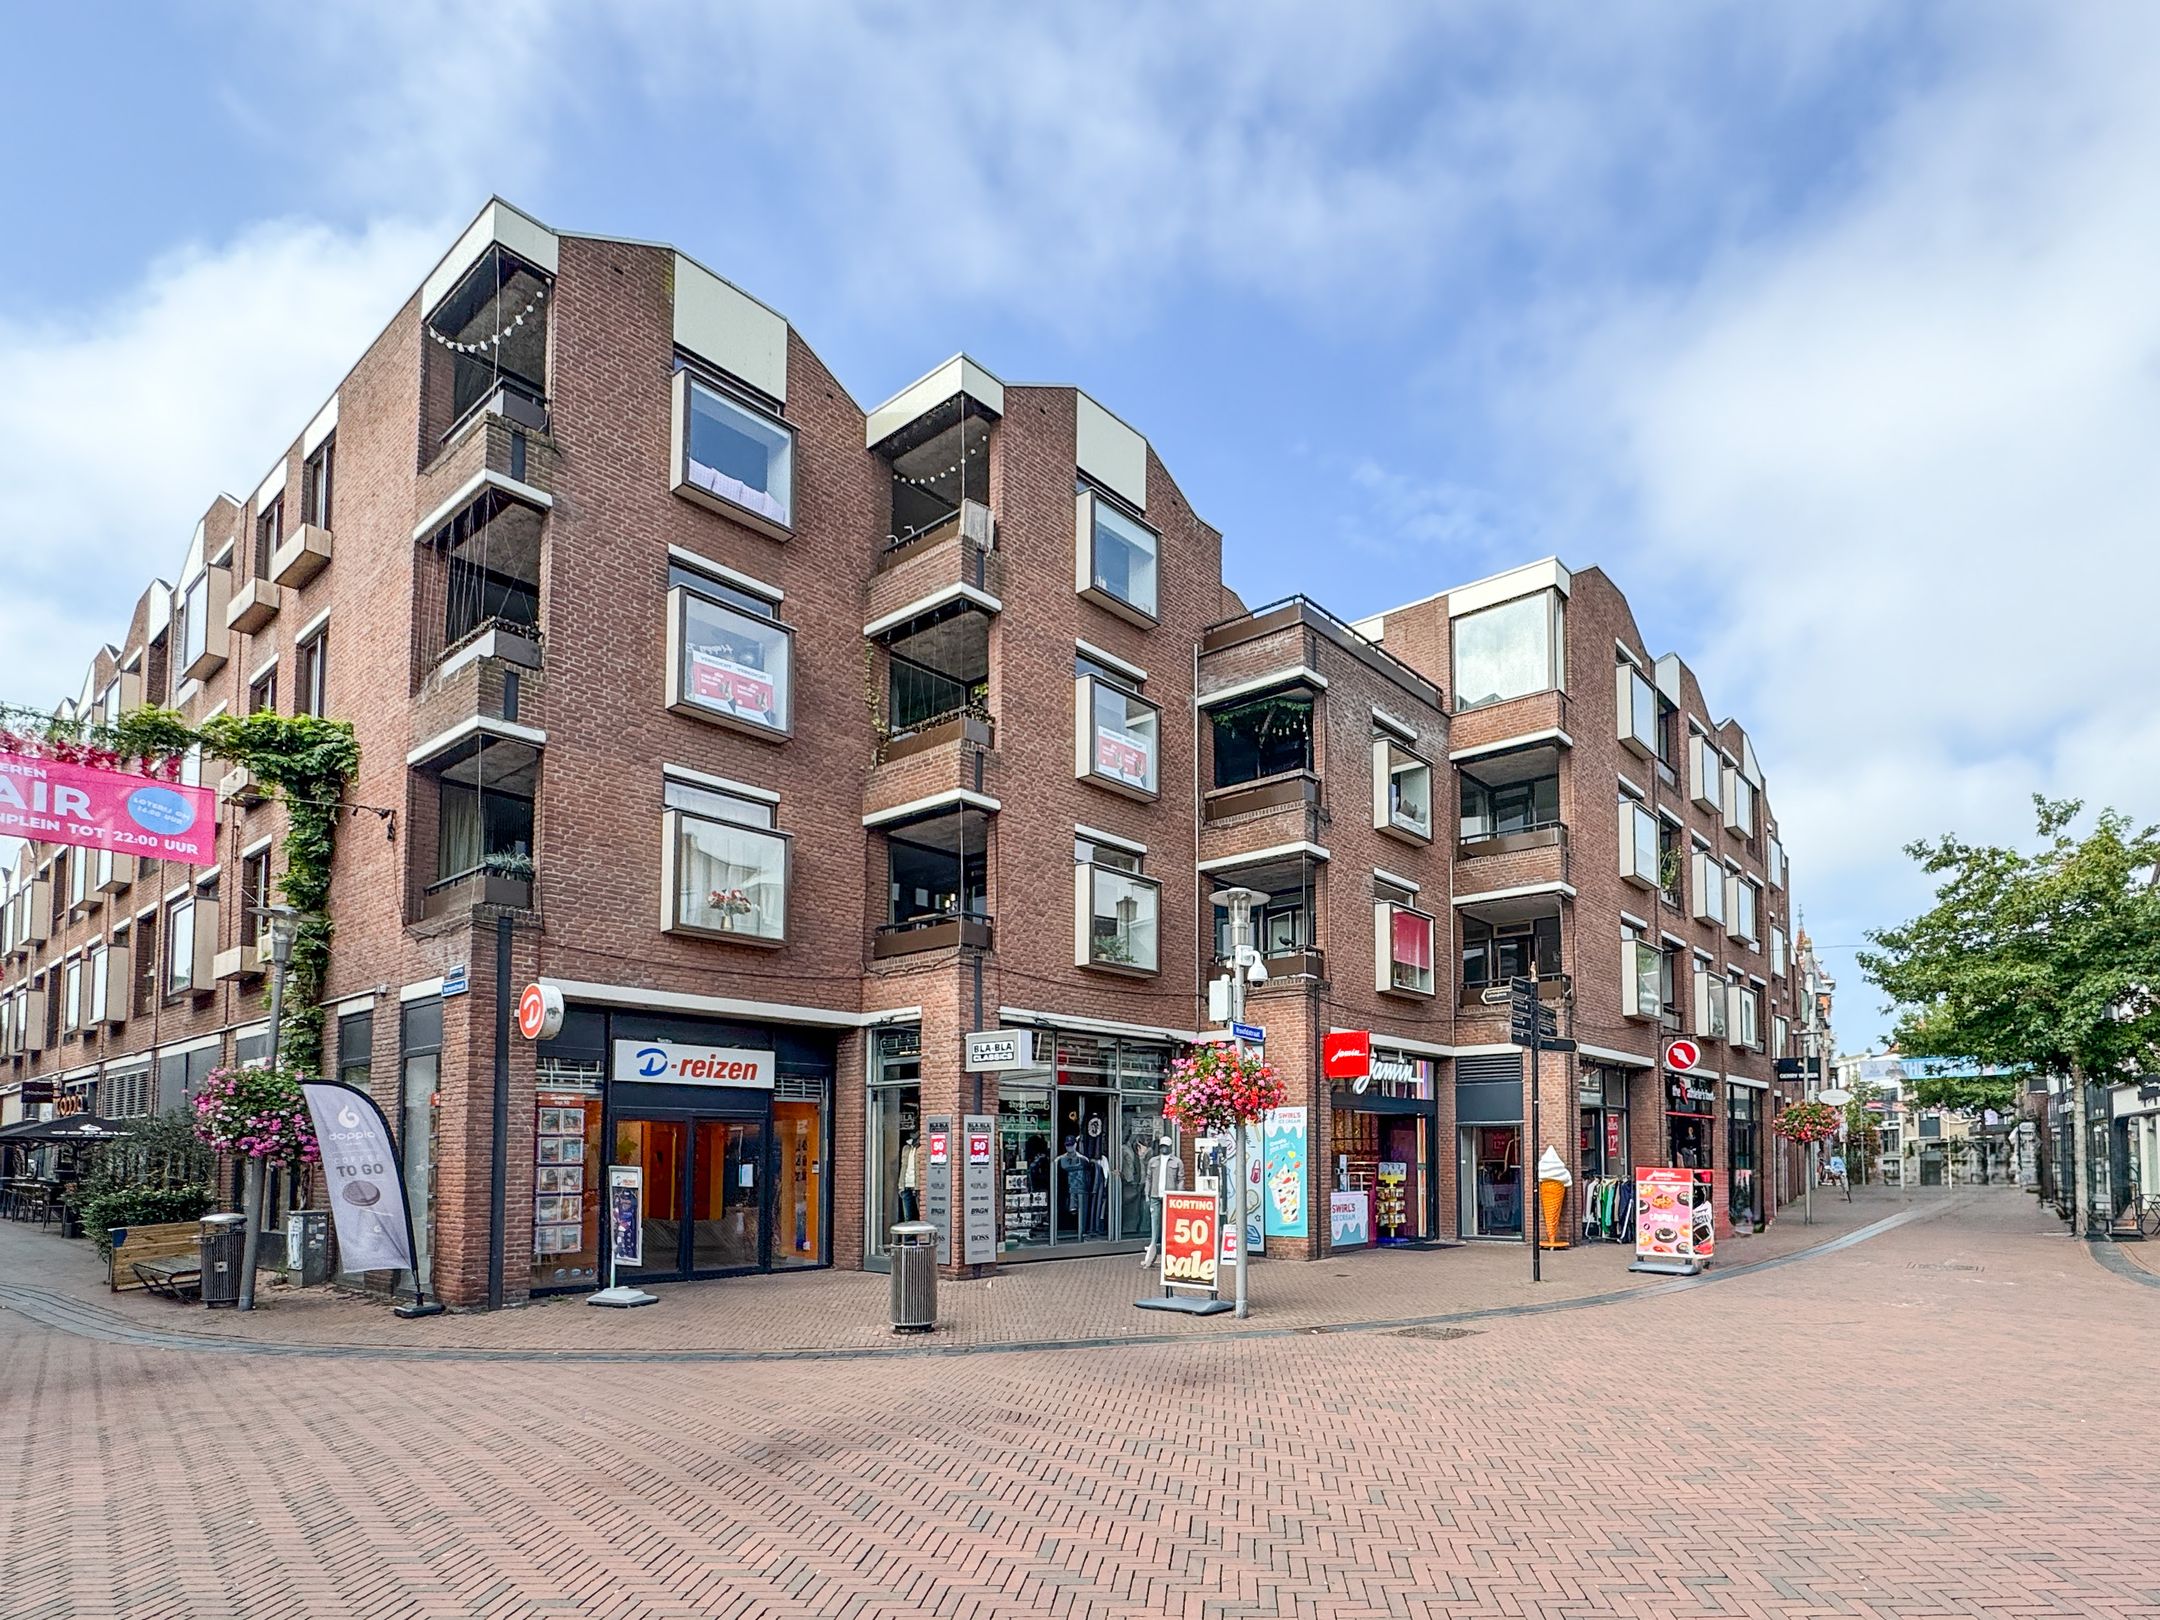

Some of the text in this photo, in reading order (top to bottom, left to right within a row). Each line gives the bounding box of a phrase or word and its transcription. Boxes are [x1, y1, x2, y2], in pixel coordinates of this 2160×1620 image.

[67, 823, 105, 839] TOT
[164, 839, 198, 855] UUR
[636, 1047, 758, 1080] D-reizen
[973, 1053, 1014, 1062] CLASSICS
[336, 1163, 384, 1177] TO GO
[1169, 1198, 1214, 1211] KORTING
[1164, 1250, 1215, 1280] sale
